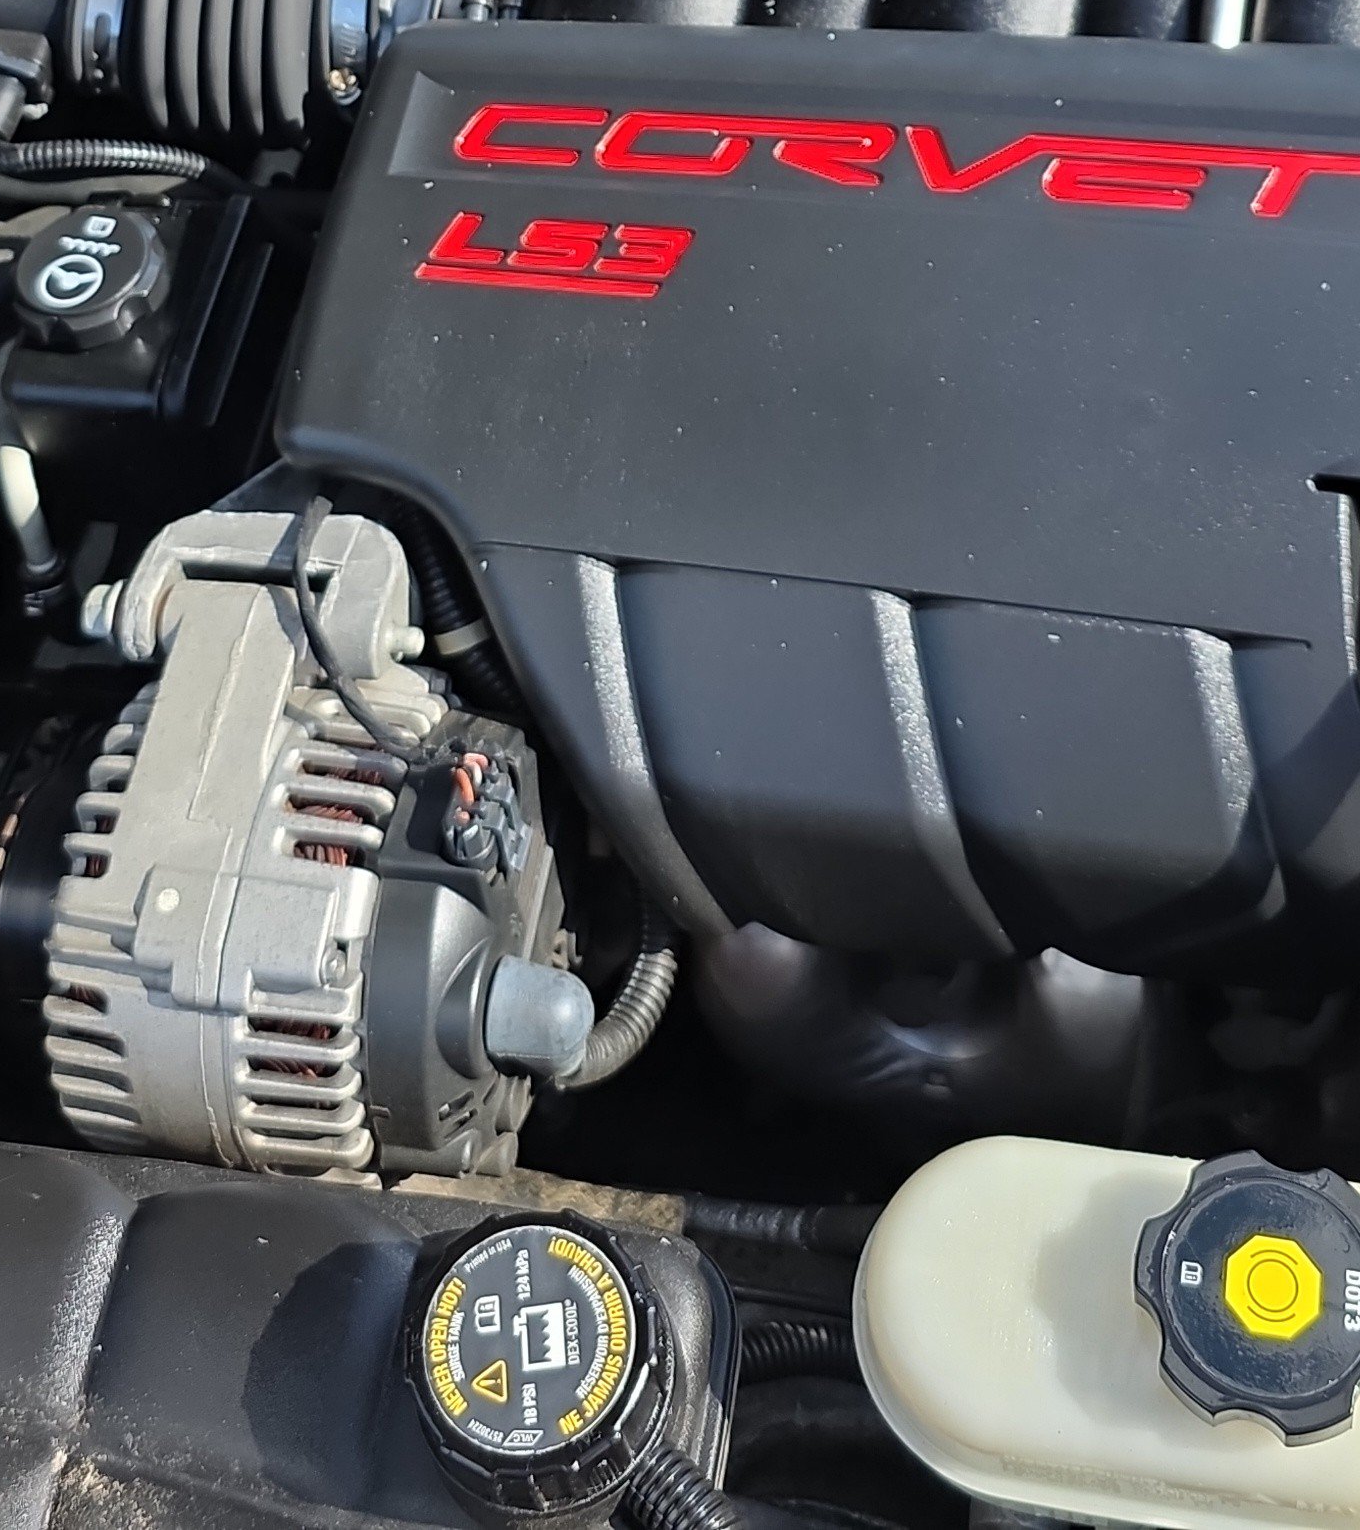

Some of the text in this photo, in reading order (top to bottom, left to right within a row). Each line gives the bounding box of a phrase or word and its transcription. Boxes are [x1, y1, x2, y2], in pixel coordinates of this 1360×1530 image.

[428, 211, 694, 280] LS3
[495, 1237, 513, 1252] USA
[547, 1235, 603, 1283] CHAUD!
[516, 1275, 531, 1301] 124
[567, 1264, 609, 1335] D'EXPANSION
[596, 1272, 614, 1292] A
[430, 1276, 469, 1417] NEVER OPEN HOT!
[447, 1310, 466, 1382] SURGE TANK
[602, 1286, 627, 1352] OUVRIR
[522, 1382, 537, 1407] PSI
[574, 1335, 609, 1400] RÉSERVOIR
[582, 1354, 623, 1418] JAMAIS
[558, 1408, 584, 1435] NE
